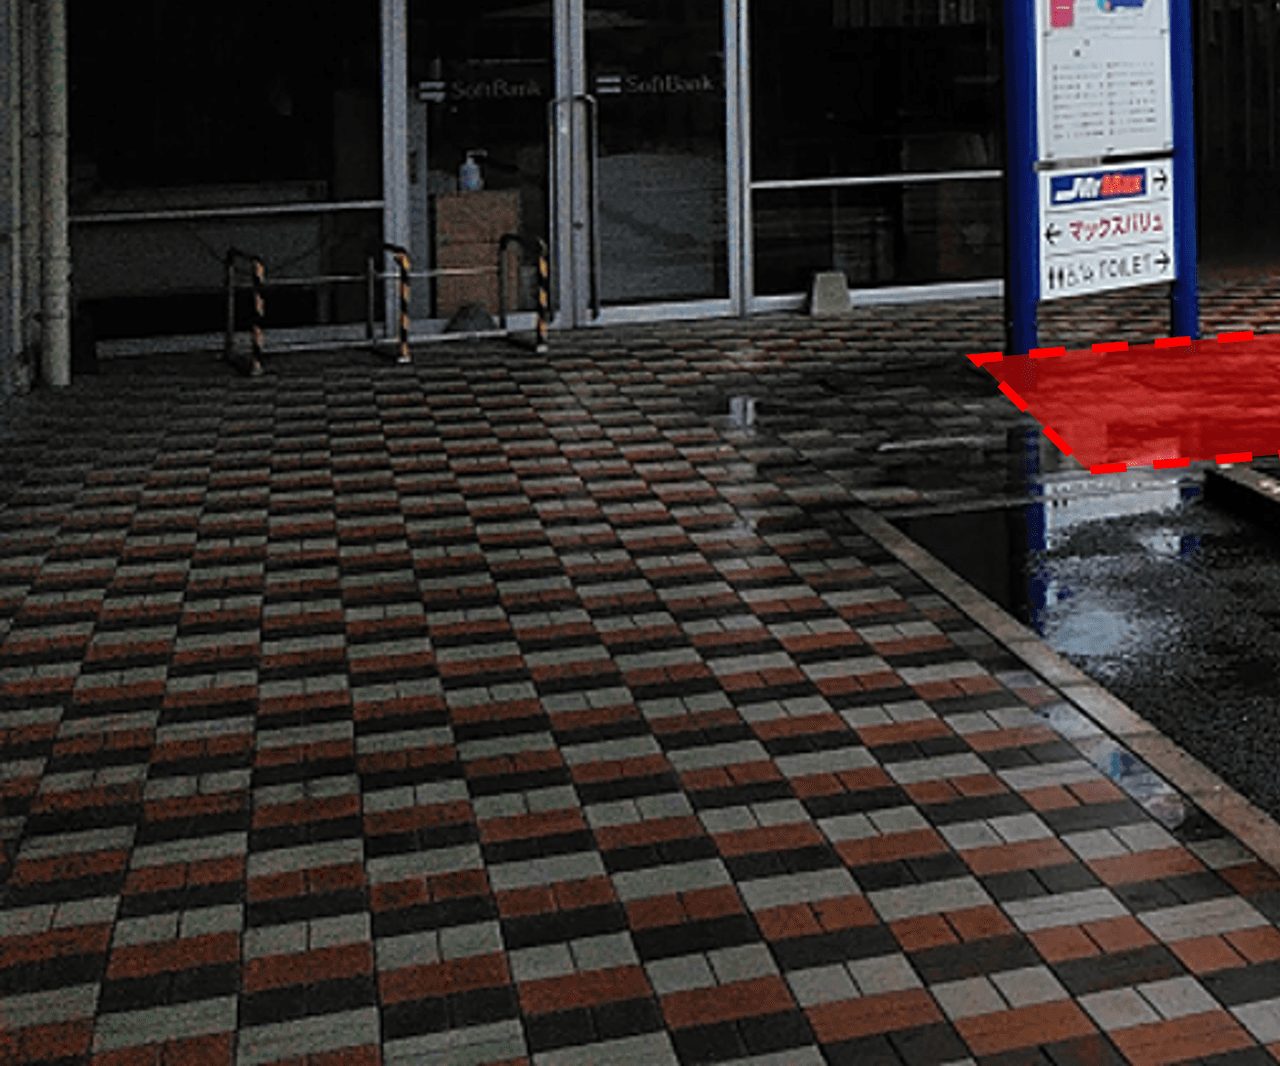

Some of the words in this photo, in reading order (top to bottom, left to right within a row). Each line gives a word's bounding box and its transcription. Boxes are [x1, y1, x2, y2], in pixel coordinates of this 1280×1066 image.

[1069, 212, 1164, 242] マックスバリュ
[1099, 253, 1152, 280] TOILET
